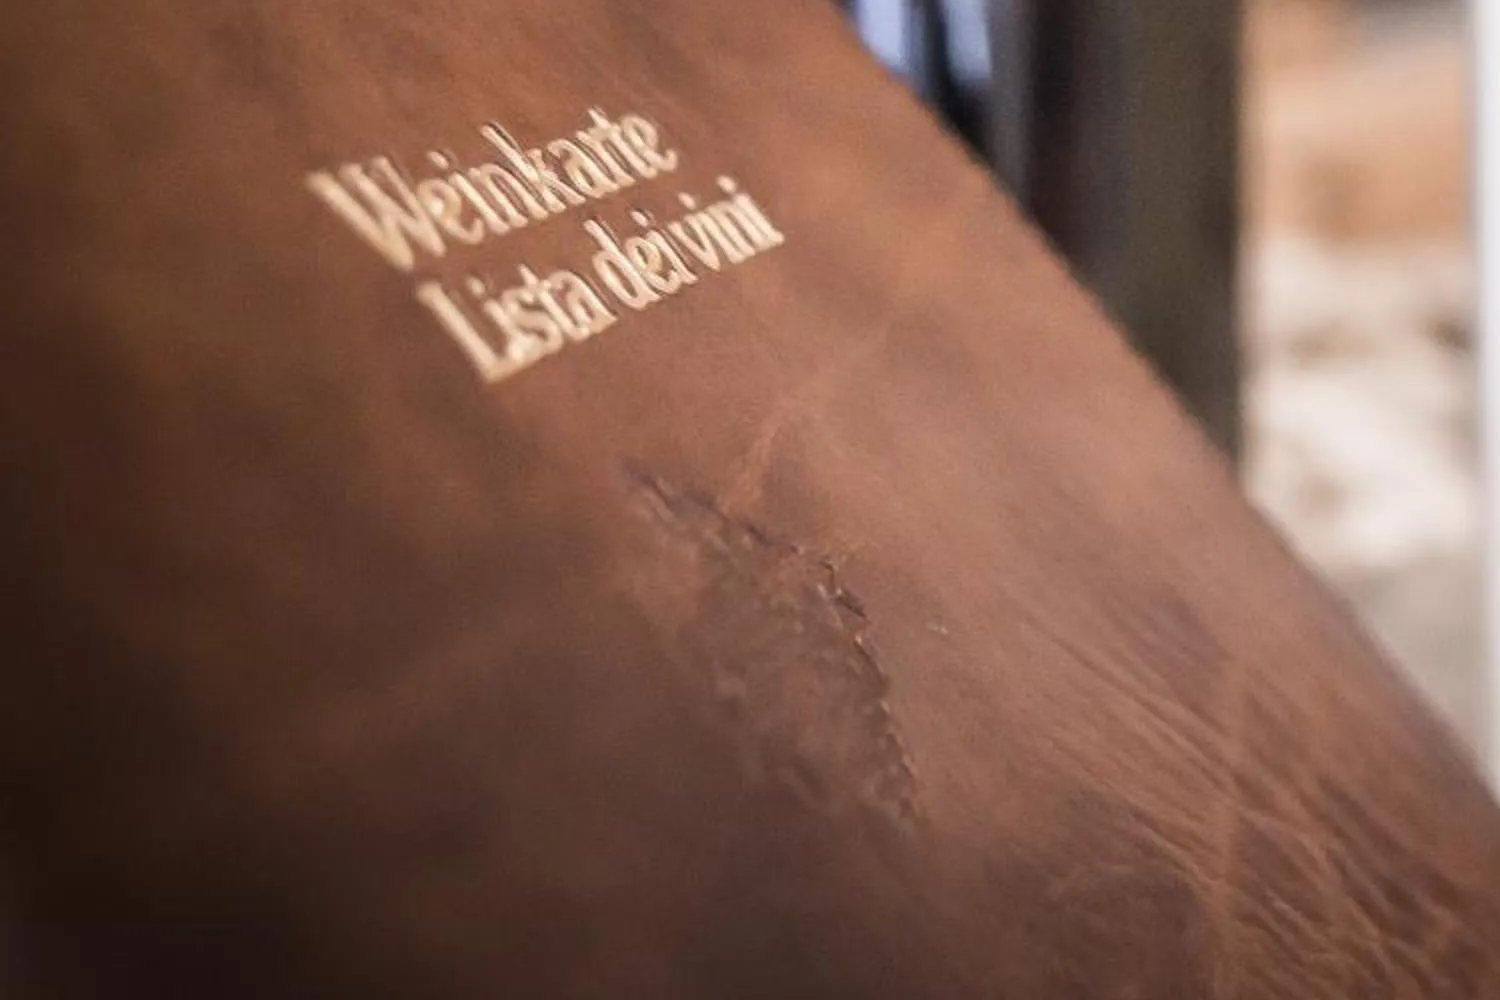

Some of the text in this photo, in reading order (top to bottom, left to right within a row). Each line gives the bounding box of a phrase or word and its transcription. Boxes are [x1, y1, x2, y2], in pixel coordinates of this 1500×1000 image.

[305, 106, 678, 271] Weinkarte
[417, 175, 785, 384] Lista dei vini
